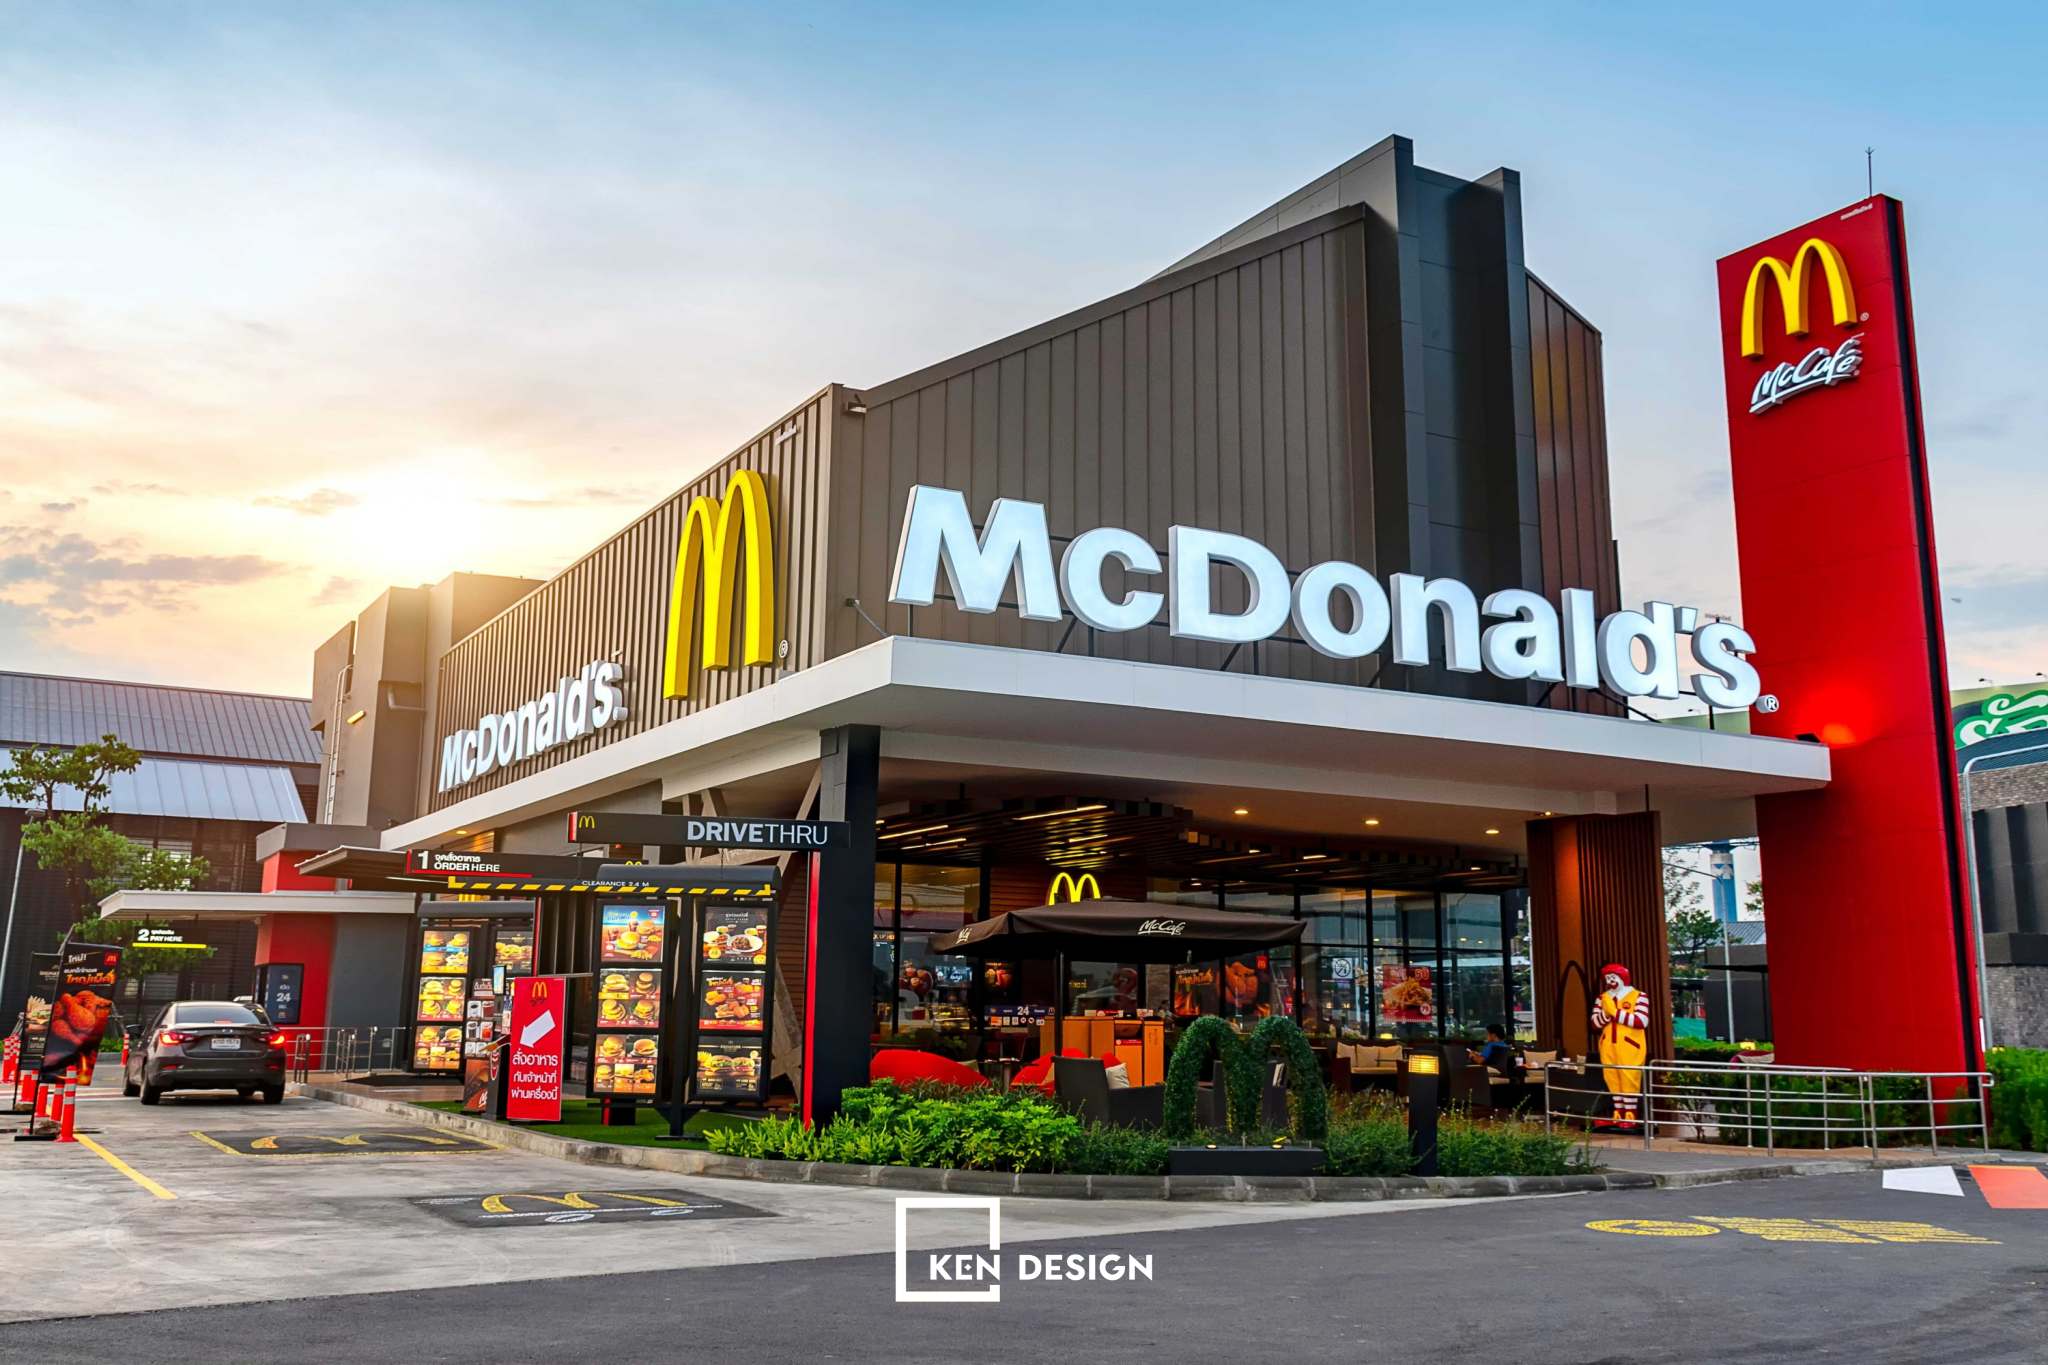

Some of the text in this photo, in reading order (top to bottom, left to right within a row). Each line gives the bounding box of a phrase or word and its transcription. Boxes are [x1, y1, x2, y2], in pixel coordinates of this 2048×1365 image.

[1749, 332, 1863, 412] McCafé
[888, 484, 1762, 710] McDonald's
[438, 659, 624, 794] McDonald's
[418, 850, 429, 870] 1
[433, 861, 500, 873] ORDER HERE
[581, 879, 626, 887] CLEARANCE
[137, 928, 150, 942] 2
[512, 1048, 559, 1067] สั่งอาหาร
